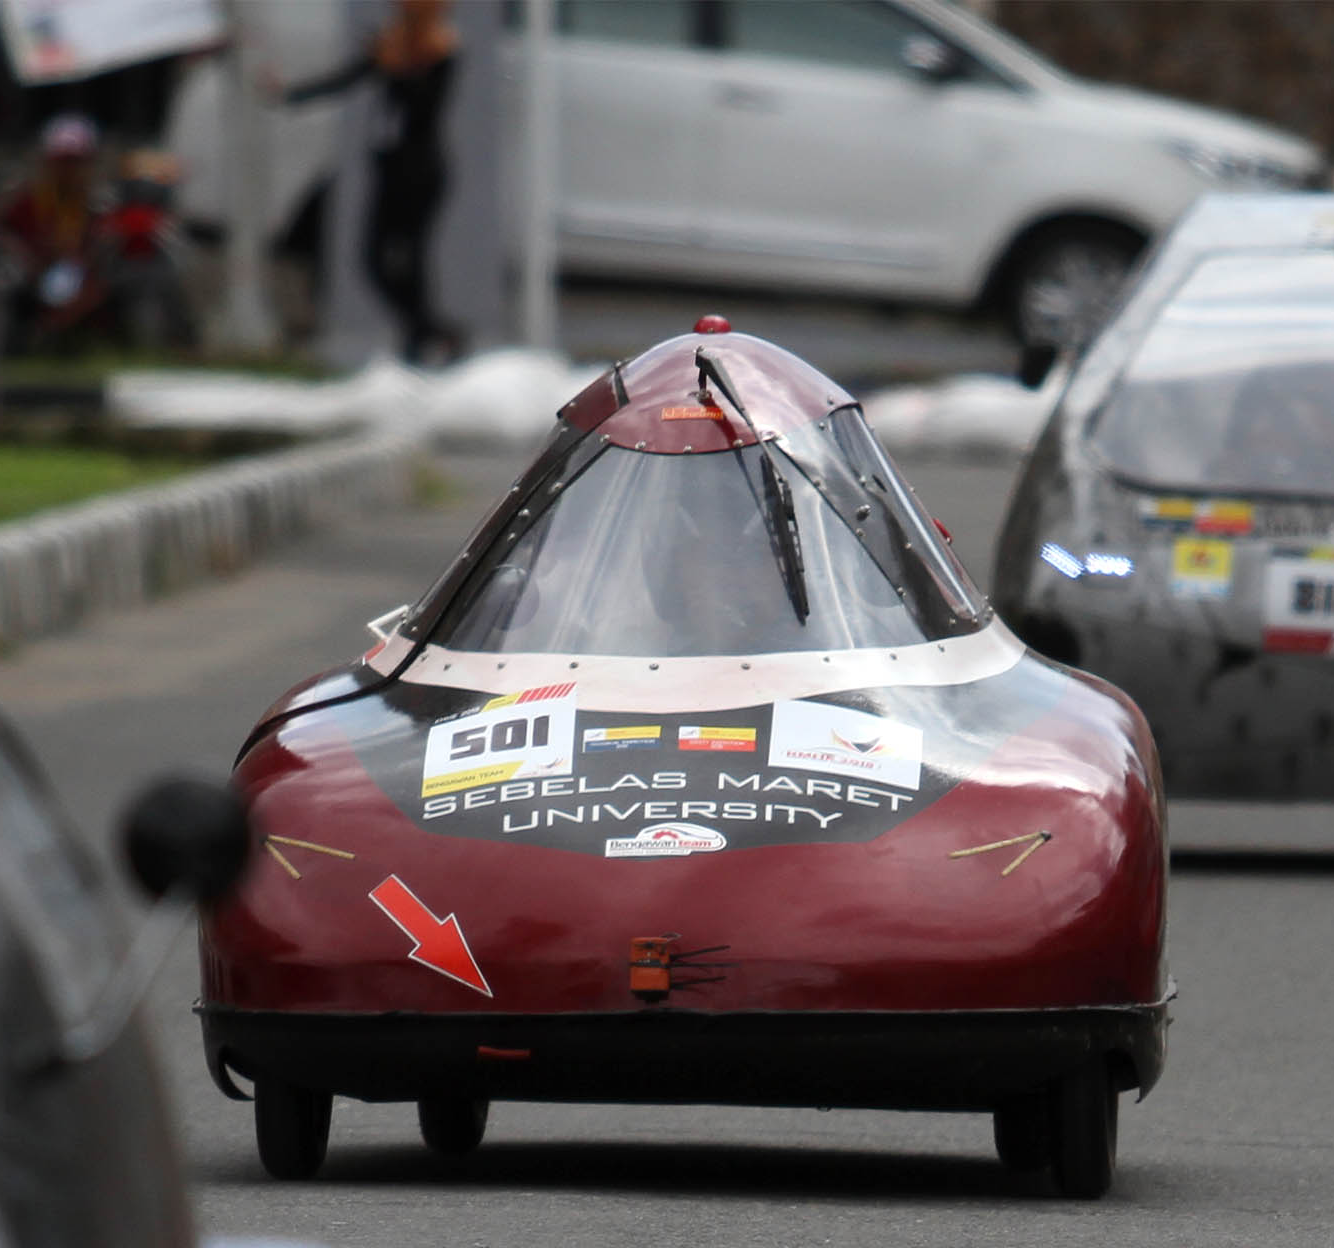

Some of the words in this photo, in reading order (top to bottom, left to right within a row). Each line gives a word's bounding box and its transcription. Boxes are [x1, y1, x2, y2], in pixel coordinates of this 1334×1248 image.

[449, 715, 551, 761] 501
[422, 772, 687, 820] SEBELAS
[718, 772, 914, 812] MARET
[503, 800, 843, 833] UNIVERSITY
[610, 840, 676, 850] Bengawan
[678, 840, 712, 848] team
